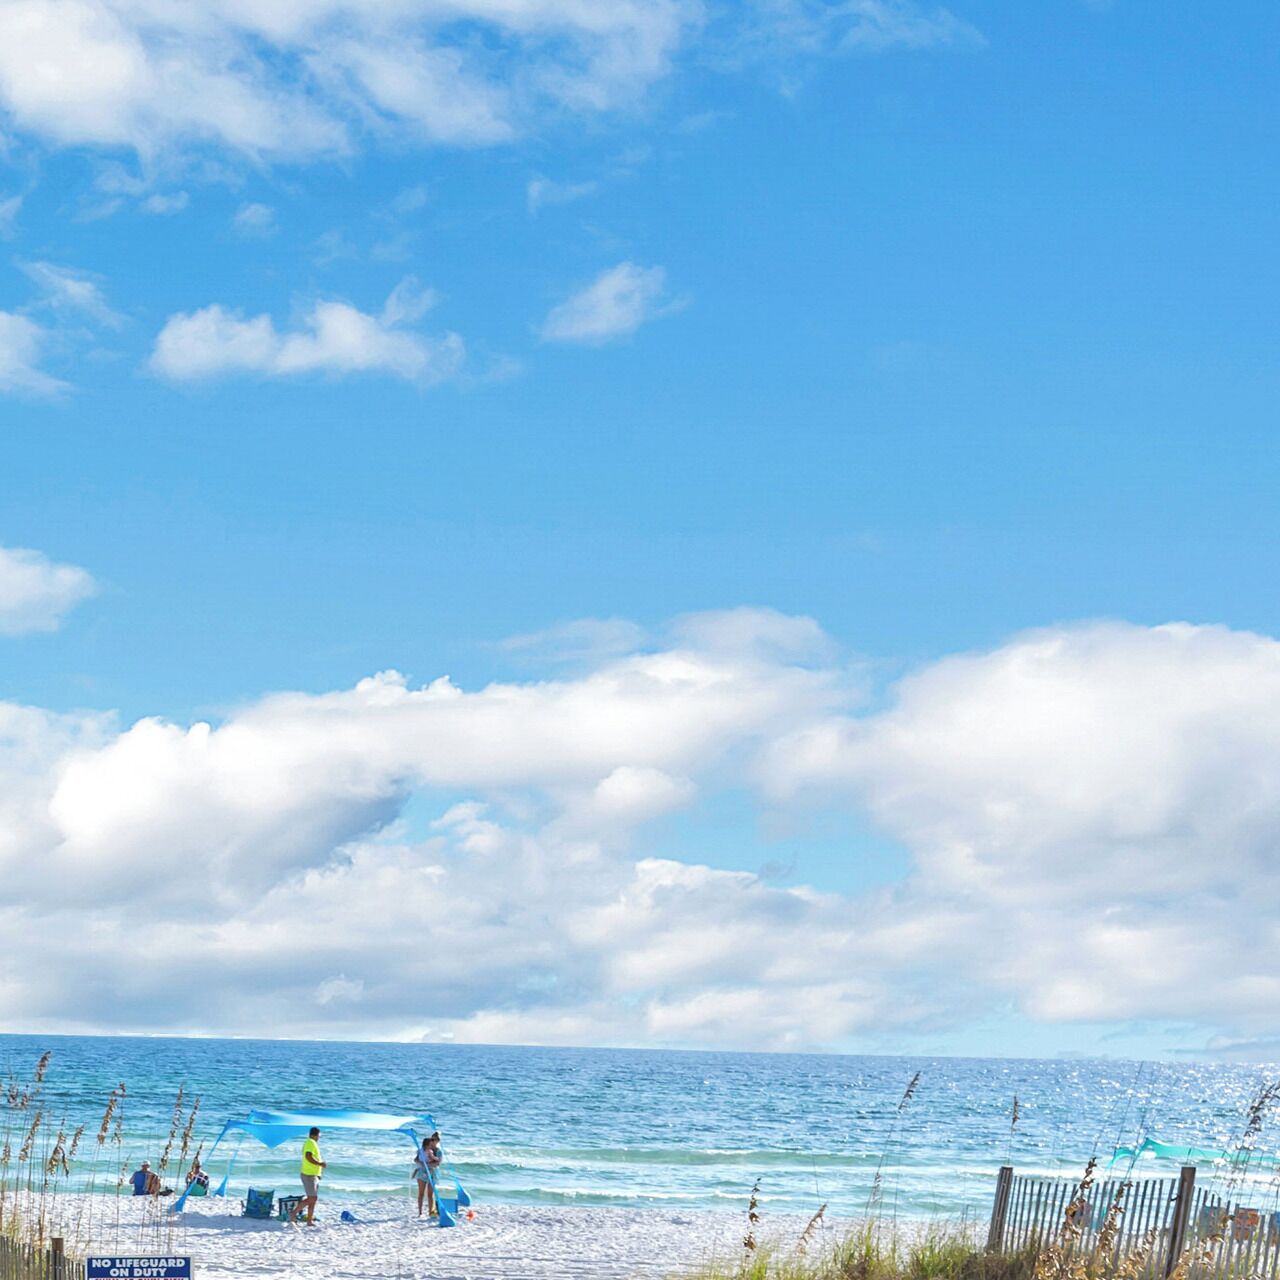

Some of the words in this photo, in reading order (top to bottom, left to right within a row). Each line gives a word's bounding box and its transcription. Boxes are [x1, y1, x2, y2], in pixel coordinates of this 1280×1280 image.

[91, 1259, 112, 1268] NO
[115, 1258, 186, 1268] LIFEGUARD
[109, 1268, 129, 1277] ON
[133, 1268, 167, 1277] DUTY
